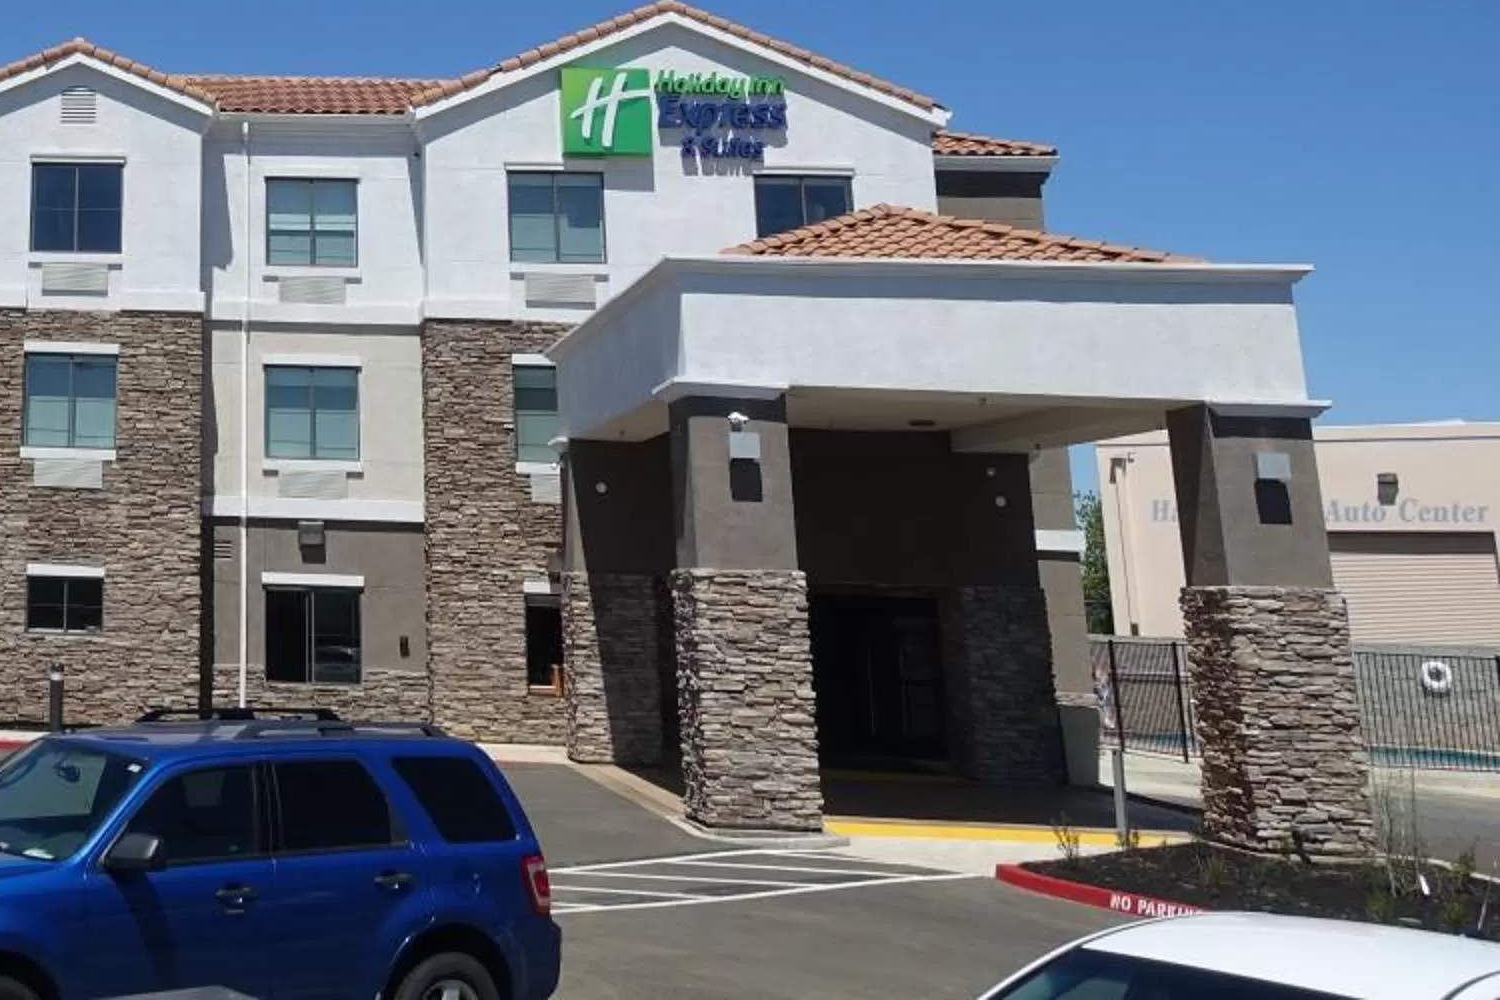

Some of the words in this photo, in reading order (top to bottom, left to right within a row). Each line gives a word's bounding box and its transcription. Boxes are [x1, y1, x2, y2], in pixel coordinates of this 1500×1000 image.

[655, 69, 746, 99] Holiday
[658, 95, 787, 136] Express
[700, 137, 765, 159] Suites
[1326, 498, 1387, 523] Auto
[1398, 496, 1489, 523] Center
[1109, 893, 1132, 911] NO
